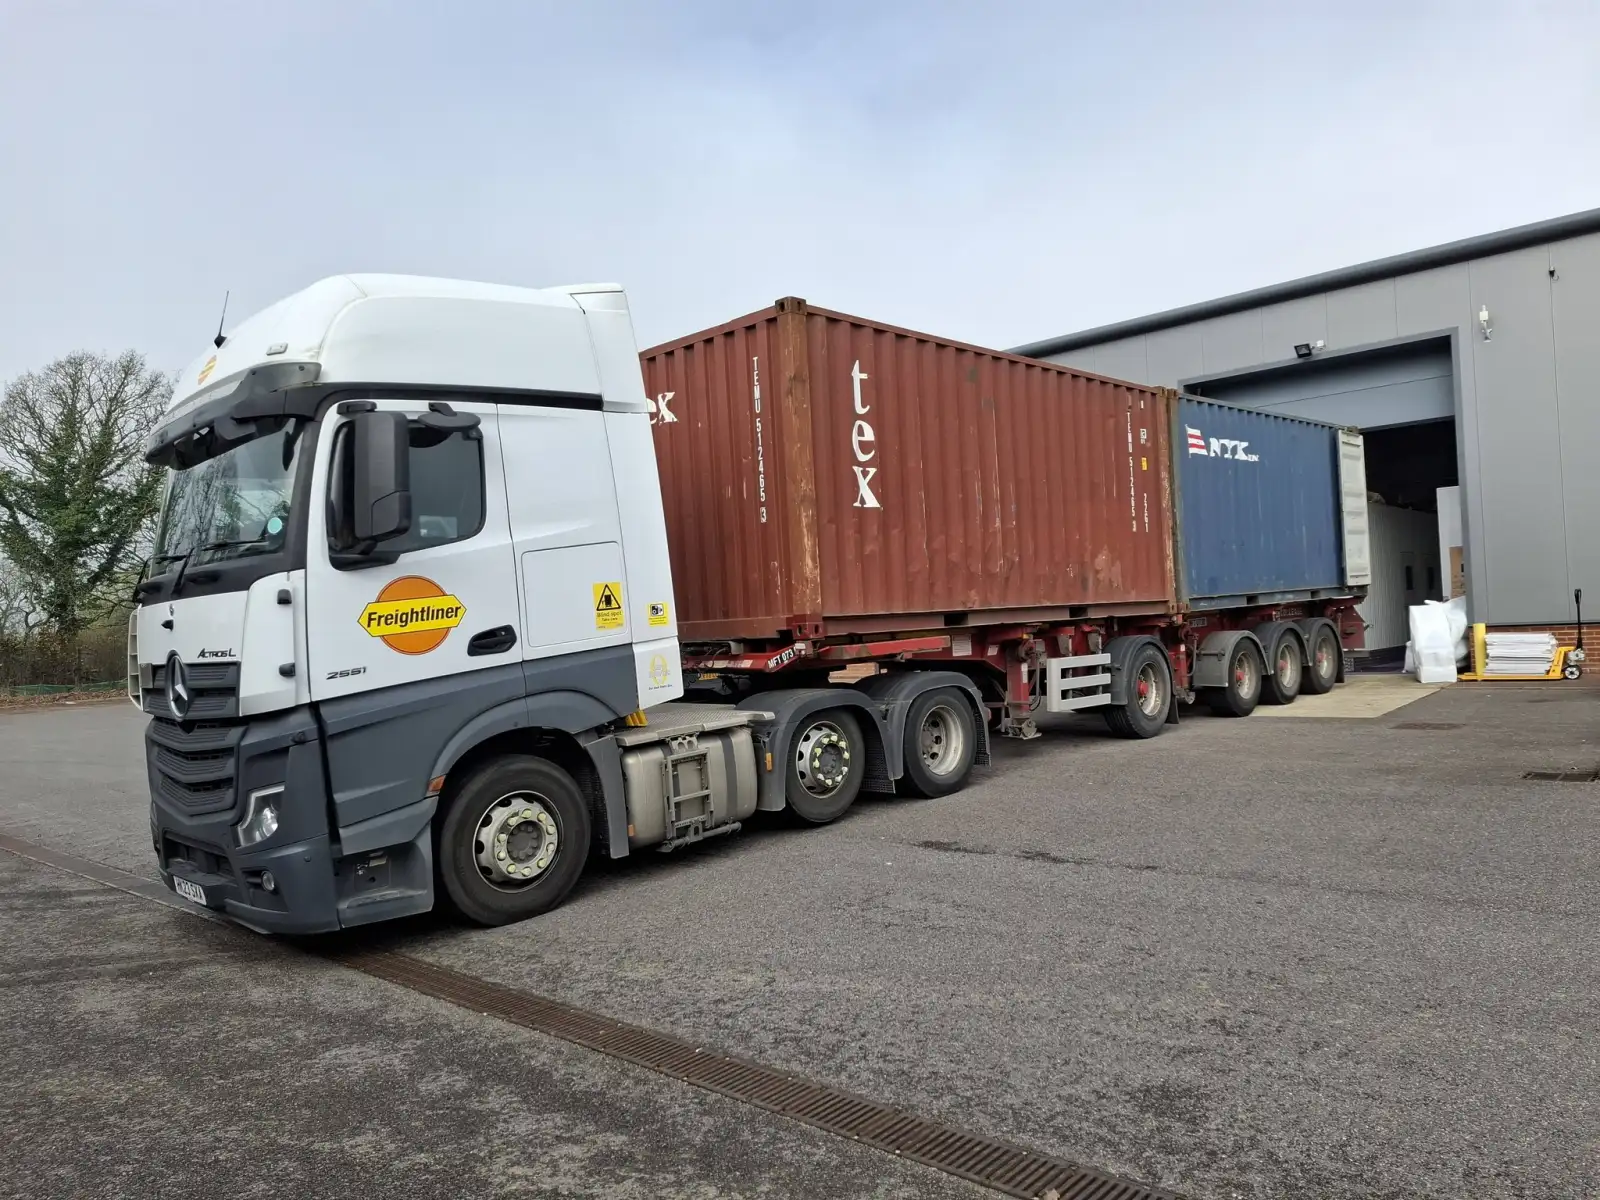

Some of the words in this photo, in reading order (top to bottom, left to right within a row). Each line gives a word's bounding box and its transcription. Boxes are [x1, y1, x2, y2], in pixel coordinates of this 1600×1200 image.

[753, 356, 761, 413] TEMU
[646, 391, 678, 425] ex
[851, 360, 881, 508] tex
[756, 418, 766, 502] 512465
[1209, 437, 1249, 460] NYK
[760, 507, 767, 523] 3
[367, 605, 461, 628] Freightliner
[326, 666, 367, 680] 2551
[767, 654, 782, 669] MFT
